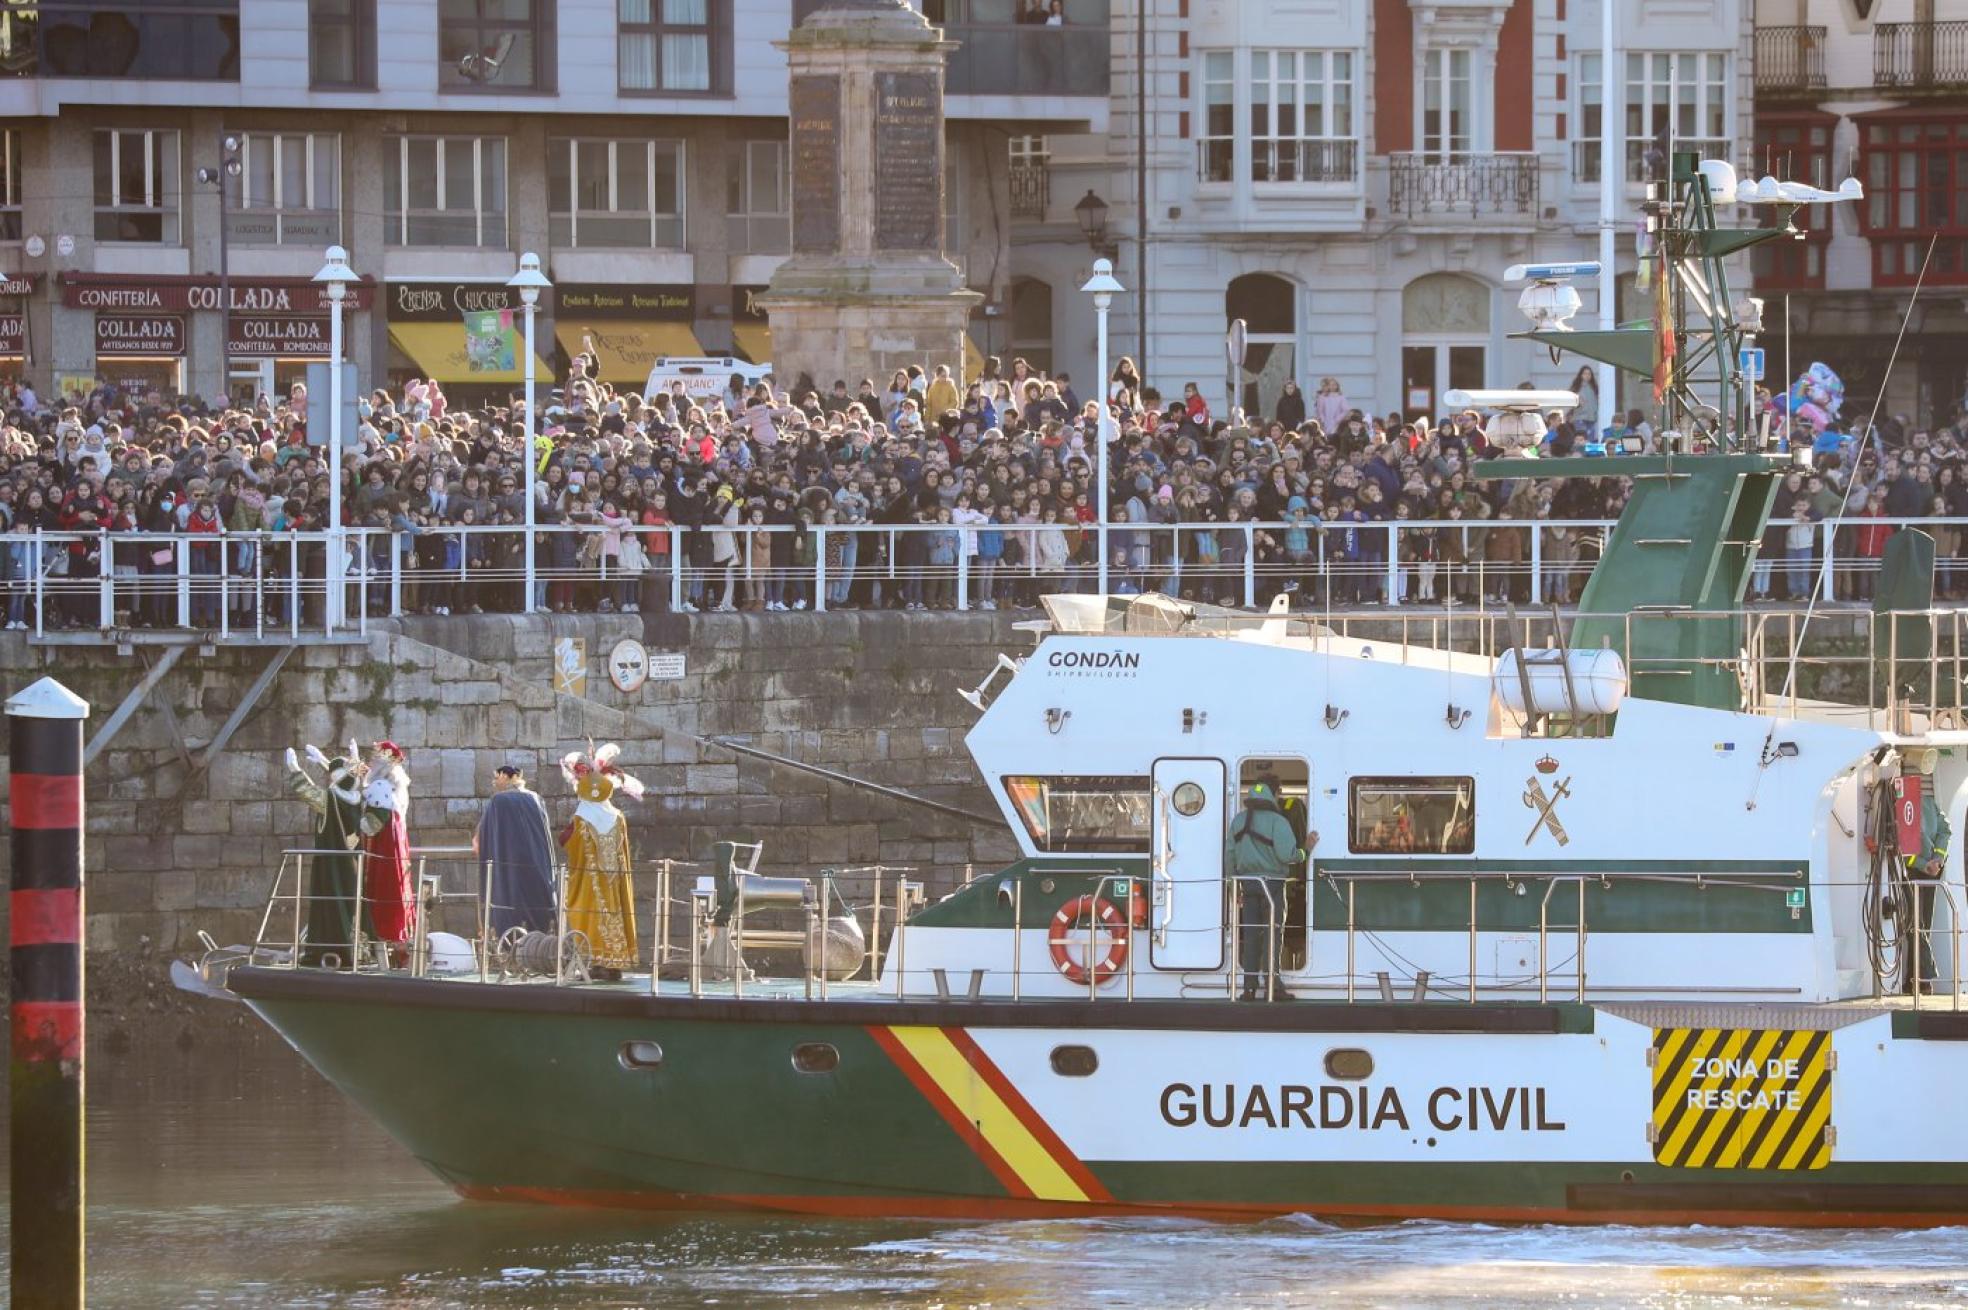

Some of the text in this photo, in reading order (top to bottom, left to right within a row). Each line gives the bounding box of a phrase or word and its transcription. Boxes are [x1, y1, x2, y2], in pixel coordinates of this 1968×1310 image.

[79, 287, 161, 306] CONFITERÍA
[97, 320, 175, 338] COLLADA
[244, 321, 320, 338] COLLADA
[1048, 670, 1137, 678] SHIPBUILDERS
[1690, 1057, 1800, 1079] ZONA DE
[1159, 1083, 1566, 1132] GUARDIA CIVIL
[1687, 1088, 1802, 1111] RESCATE
